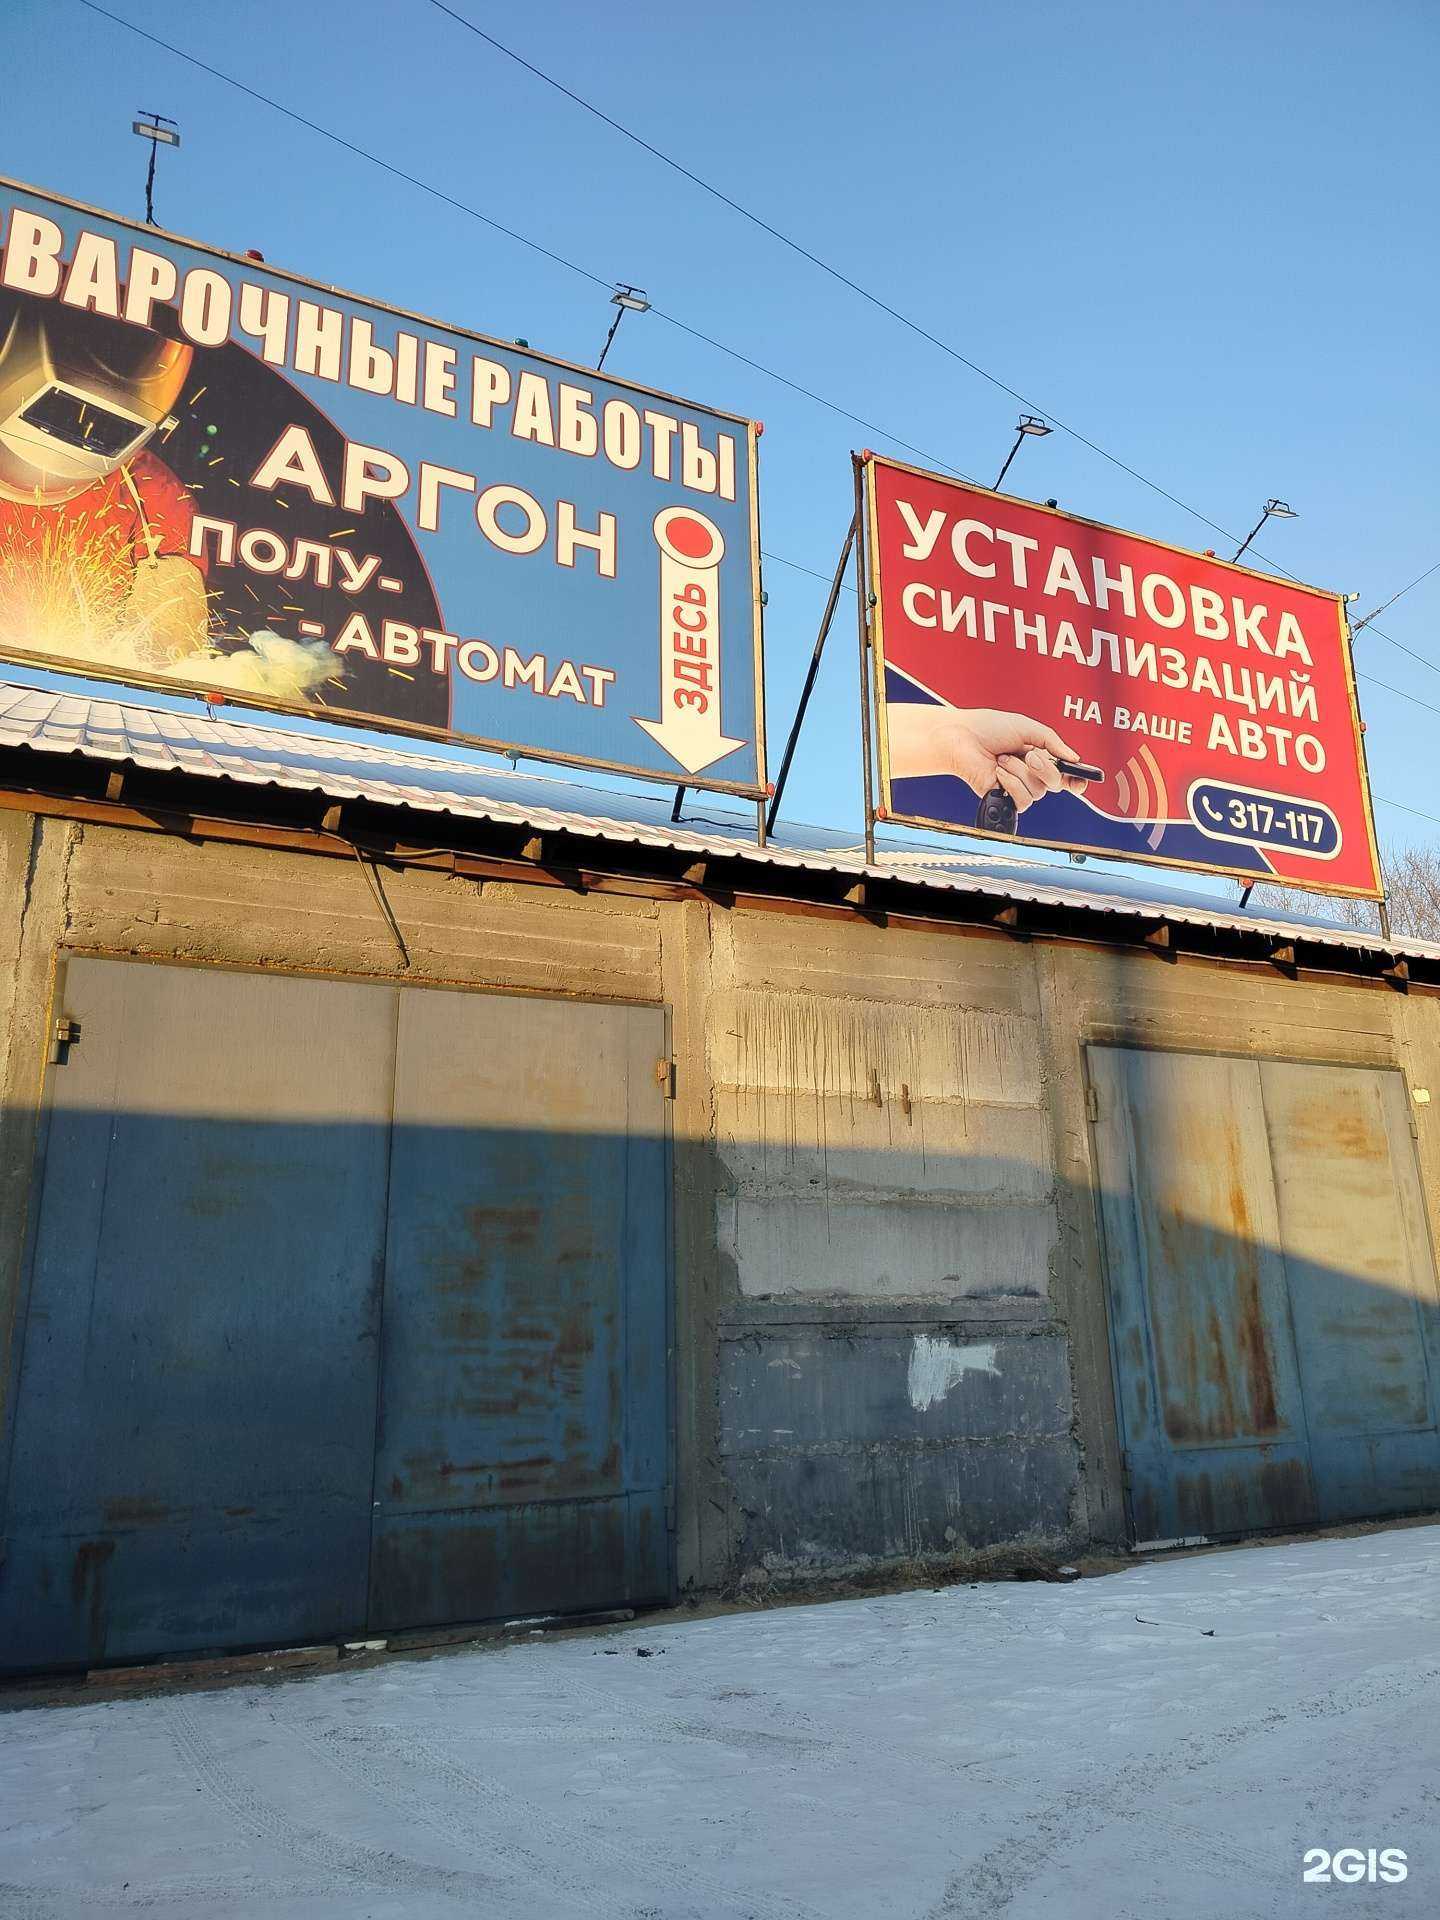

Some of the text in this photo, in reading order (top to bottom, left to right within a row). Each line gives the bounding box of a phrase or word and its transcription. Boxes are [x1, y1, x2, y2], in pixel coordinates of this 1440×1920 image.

[0, 208, 736, 501] ВАРОЧНЫЕ РАБОТЫ
[188, 514, 403, 593] ПОЛУ-
[249, 424, 617, 579] АРГОН
[673, 583, 707, 714] ЗДЕСЬ
[896, 500, 1314, 666] УСТАНОВКА
[901, 583, 1320, 722] СИГНАЛИЗАЦИЙ
[1063, 695, 1327, 774] НА ВАШЕ АВТО
[1228, 799, 1324, 844] 317-117
